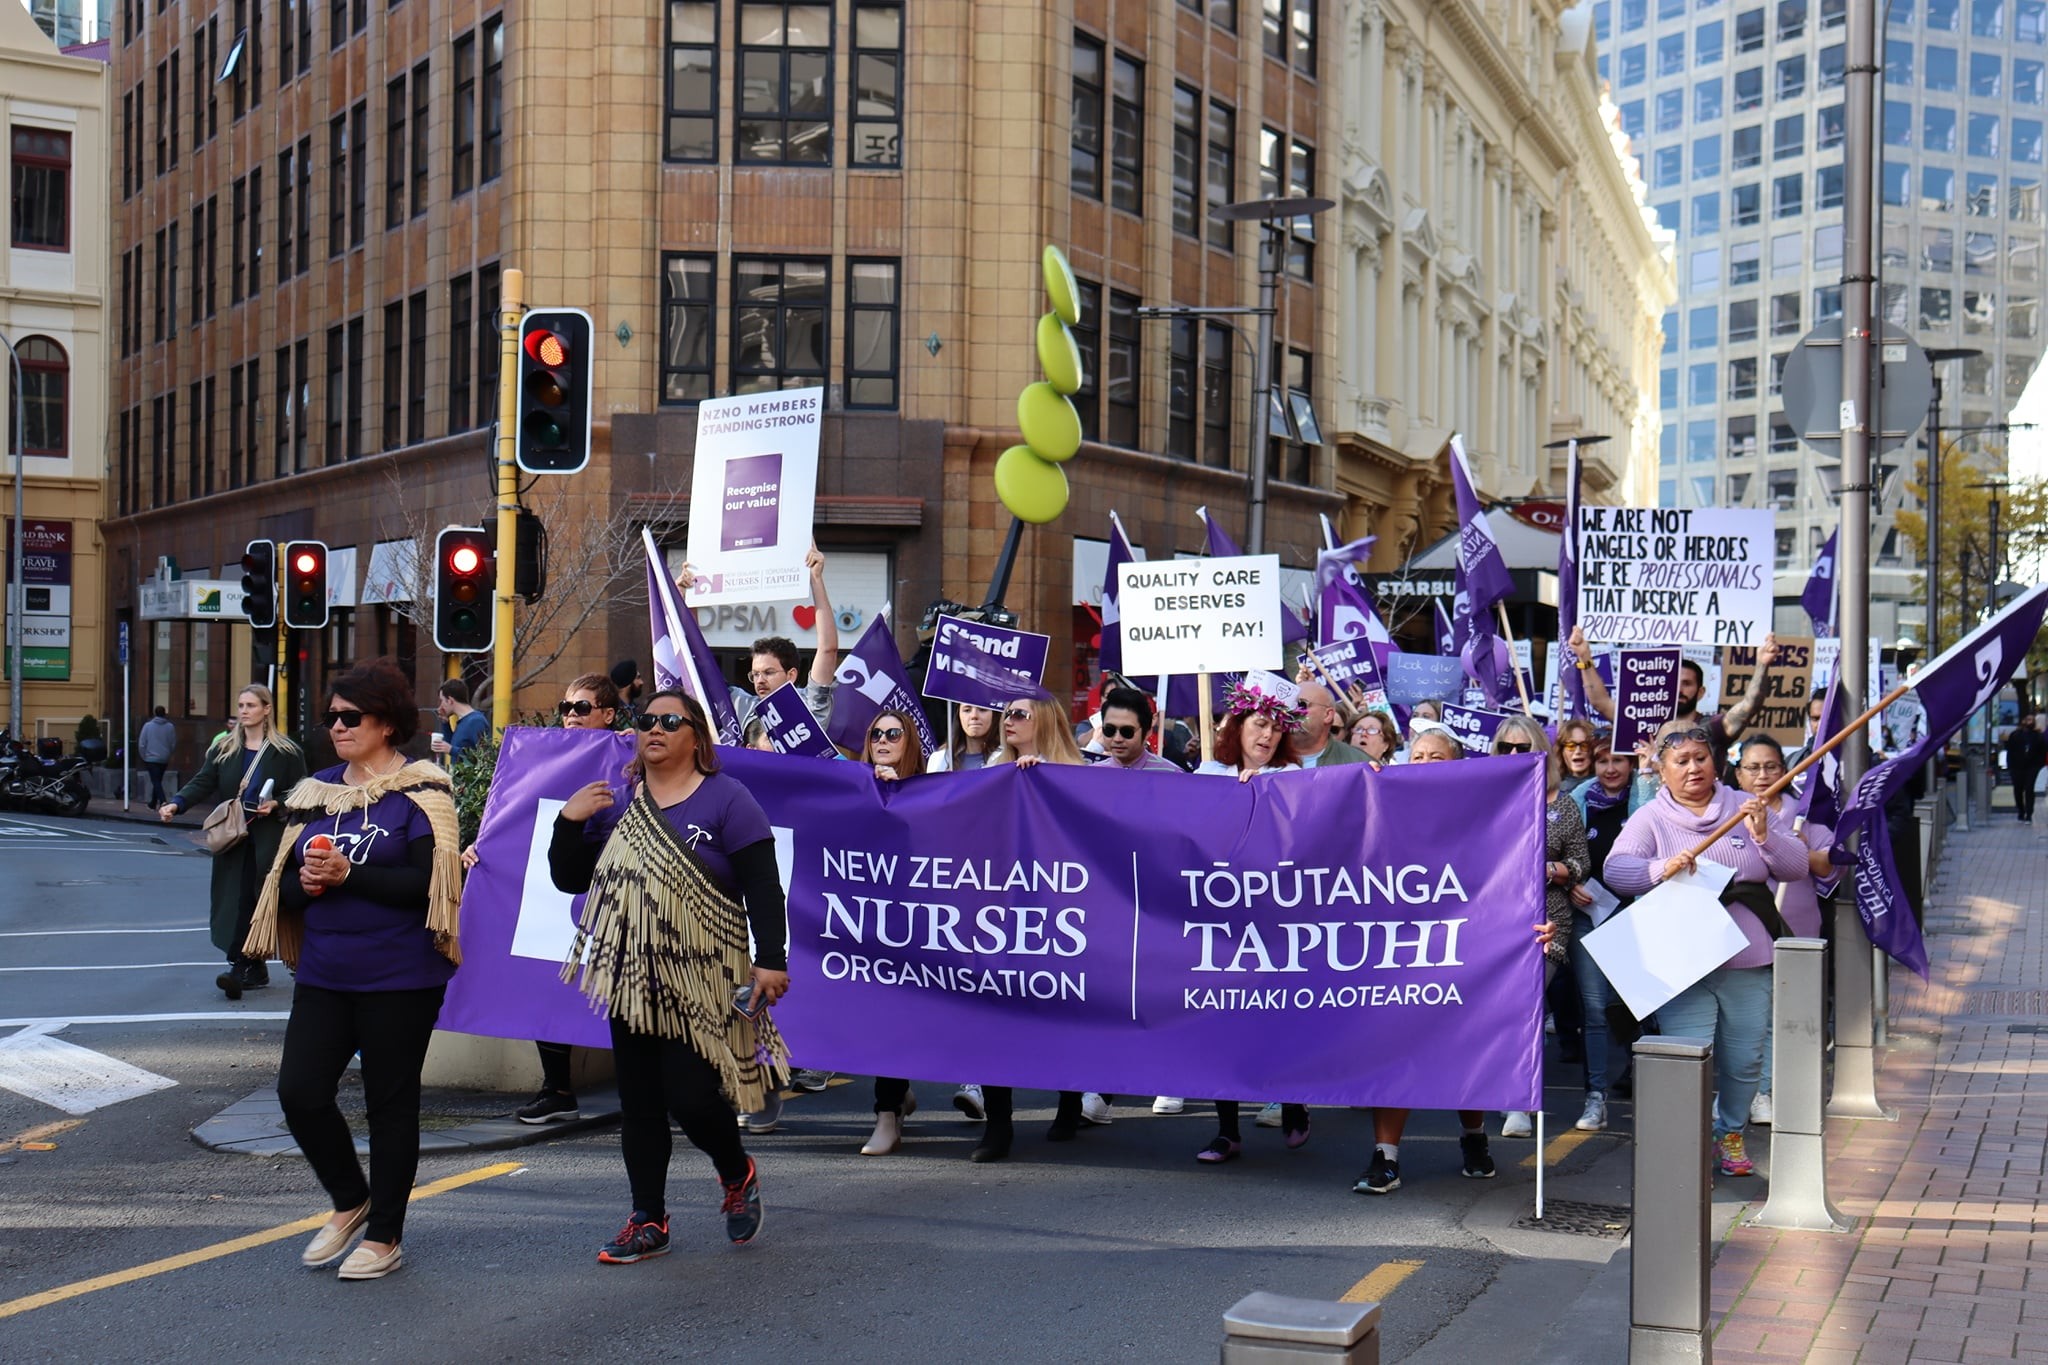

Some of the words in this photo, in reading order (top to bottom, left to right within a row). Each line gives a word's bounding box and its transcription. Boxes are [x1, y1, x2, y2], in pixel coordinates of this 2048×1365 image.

[703, 407, 741, 421] NZNO
[748, 398, 816, 416] MEMBERS
[702, 420, 763, 436] STANDING
[765, 413, 815, 429] STRONG
[726, 482, 777, 497] Recognise
[725, 500, 745, 511] our
[747, 496, 777, 508] value
[1582, 508, 1606, 532] WE
[1613, 509, 1645, 533] ARE
[1652, 510, 1692, 534] NOT
[38, 532, 65, 543] BANK
[1583, 535, 1648, 560] ANGELS
[1654, 535, 1677, 561] OR
[1684, 536, 1749, 561] HEROES
[725, 576, 760, 586] NURSES
[765, 573, 800, 584] TAPUHI
[1127, 572, 1199, 588] QUALITY
[1213, 570, 1260, 585] CARE
[1583, 562, 1632, 586] WE'RE
[1637, 562, 1762, 590] PROFESSIONALS
[1377, 581, 1456, 596] STARBU
[1155, 593, 1245, 611] DESERVES
[1583, 588, 1625, 613] THAT
[1632, 589, 1699, 615] DESERVE
[1706, 591, 1720, 615] A
[697, 606, 776, 631] OPSM
[1581, 615, 1703, 641] PROFESSIONAL
[1714, 620, 1754, 644] PAY
[11, 627, 65, 636] ORKSHOP
[1129, 624, 1201, 641] QUALITY
[1222, 621, 1263, 637] PAY!
[1626, 658, 1675, 674] Quality
[1730, 645, 1809, 667] NUSES
[1352, 661, 1372, 675] us
[1635, 674, 1666, 686] Care
[1726, 674, 1804, 698] EALS
[896, 687, 914, 707] NEW
[1630, 689, 1669, 702] needs
[1443, 708, 1482, 733] Safe
[1624, 705, 1672, 721] Quality
[783, 721, 812, 748] us
[1637, 721, 1660, 736] Pay
[823, 847, 898, 886] NEW
[908, 856, 1089, 894] ZEALAND
[1181, 860, 1469, 908] TŌPŪTANGA
[819, 892, 1087, 957] NURSES
[1183, 917, 1469, 972] TAPUHI
[821, 951, 1086, 1001] ORGANISATION
[1184, 987, 1288, 1010] KAITIAKI
[1293, 987, 1314, 1009] O
[1319, 982, 1464, 1009] AOTEAROA
